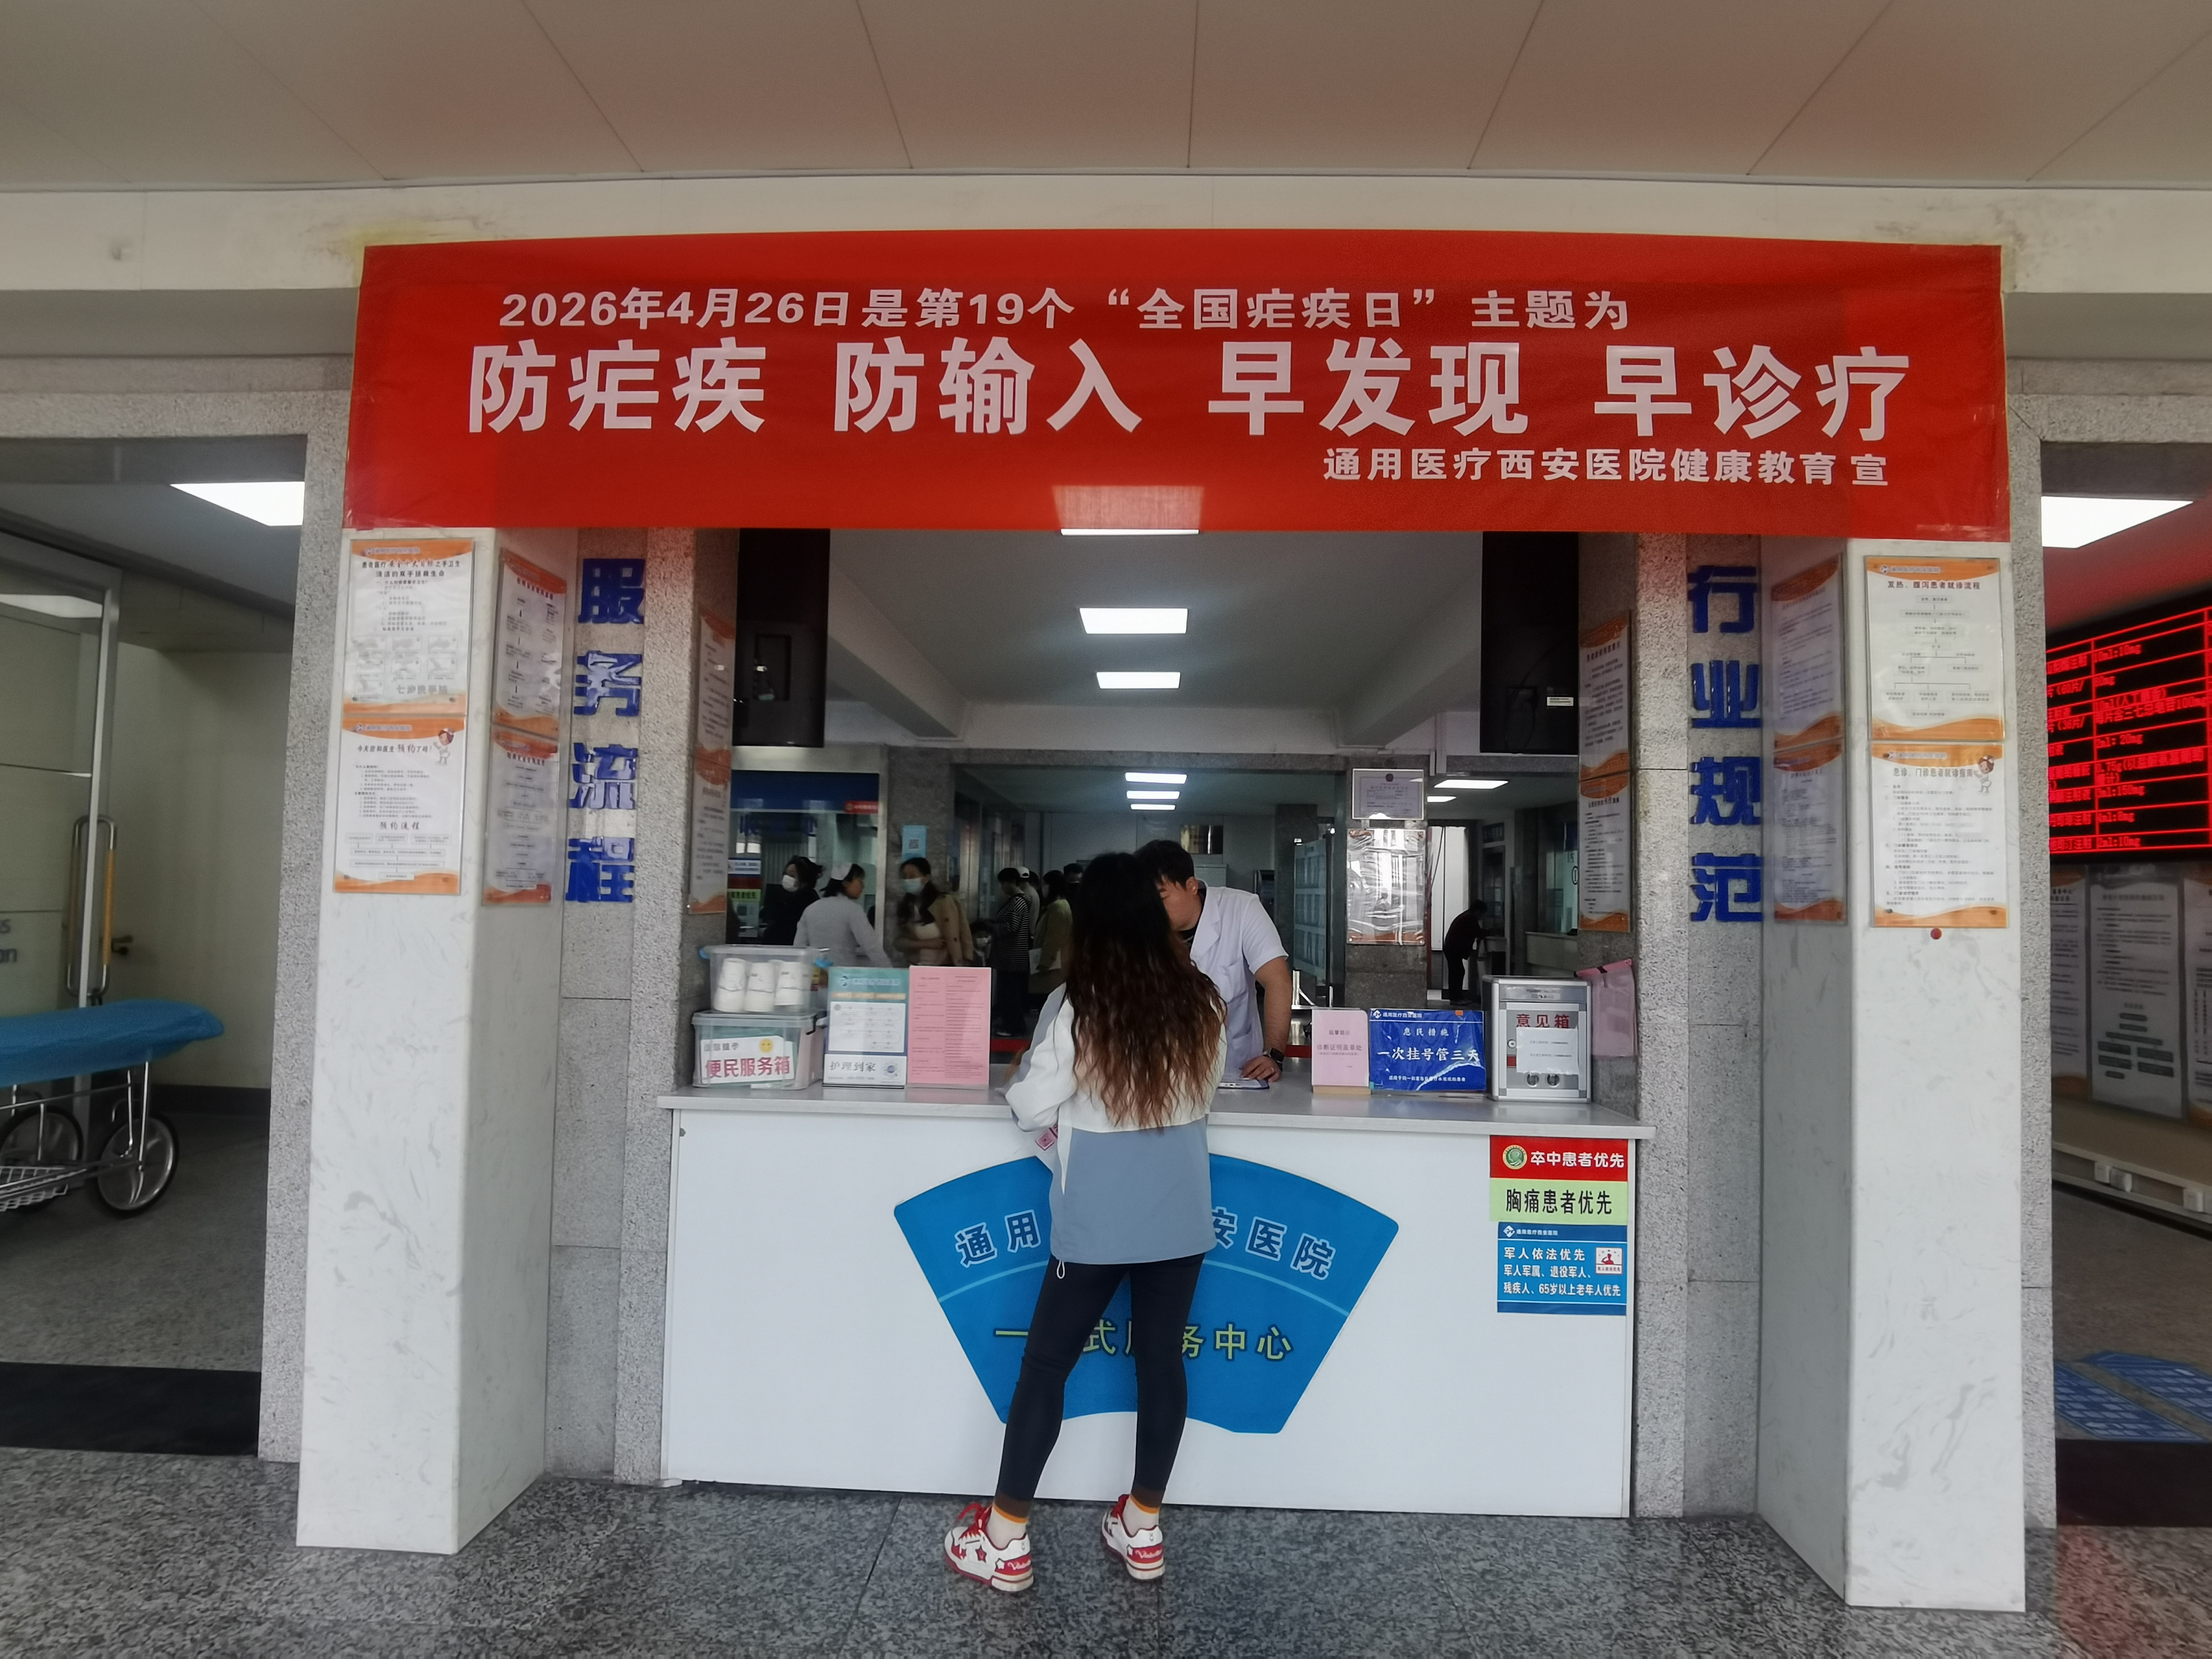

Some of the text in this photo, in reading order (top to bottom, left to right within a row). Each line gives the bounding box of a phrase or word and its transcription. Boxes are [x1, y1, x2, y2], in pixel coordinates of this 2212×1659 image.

[500, 287, 1074, 329] 2026年4月26日是第19个
[1471, 290, 1628, 330] 主题为
[469, 336, 1909, 441] 防疟疾 防输入 早发现 早诊疗
[1687, 565, 1763, 922] 行业规范
[1516, 1013, 1570, 1029] 意见箱
[1377, 1046, 1480, 1062] 一次挂号管三天
[705, 1056, 791, 1078] 便民服务箱
[830, 1061, 876, 1072] 护理到家
[1530, 1151, 1625, 1168] 卒中患者优先
[1506, 1188, 1612, 1215] 胸痛患者优先
[955, 1205, 1336, 1281] 通用安医院
[1503, 1246, 1586, 1262] 军人依法优先
[1503, 1281, 1622, 1298] 残疾人、65岁以上老年人优先
[995, 1318, 1293, 1360] 一式务中心
